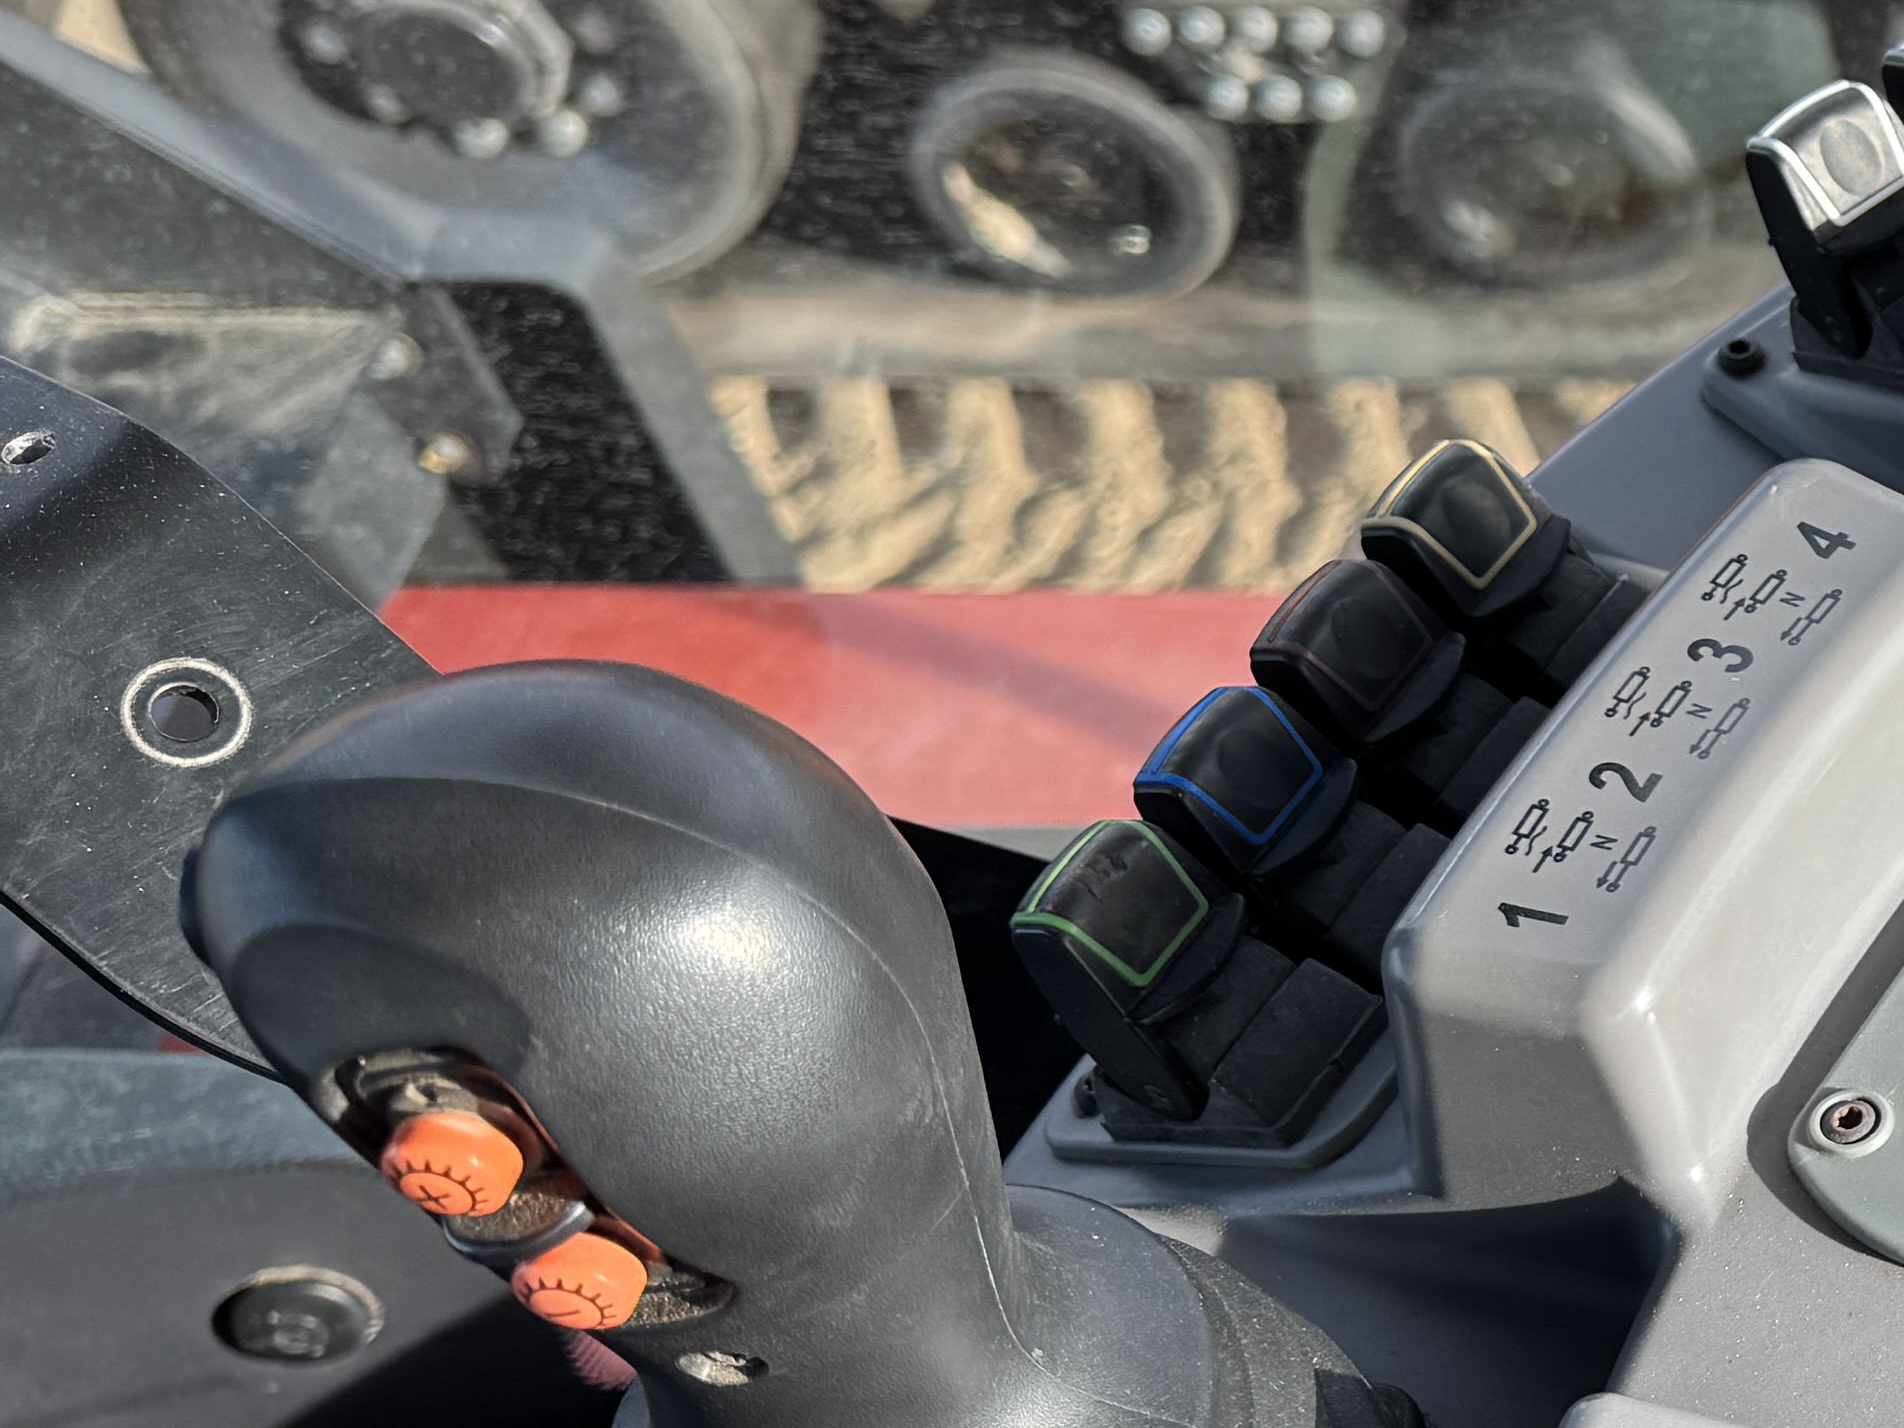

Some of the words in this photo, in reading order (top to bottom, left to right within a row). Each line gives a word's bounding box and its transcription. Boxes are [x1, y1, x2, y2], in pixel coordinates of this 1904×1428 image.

[1497, 901, 1569, 928] 1
[1588, 761, 1663, 803] 2
[1686, 638, 1754, 673] 3
[1796, 521, 1857, 560] 4
